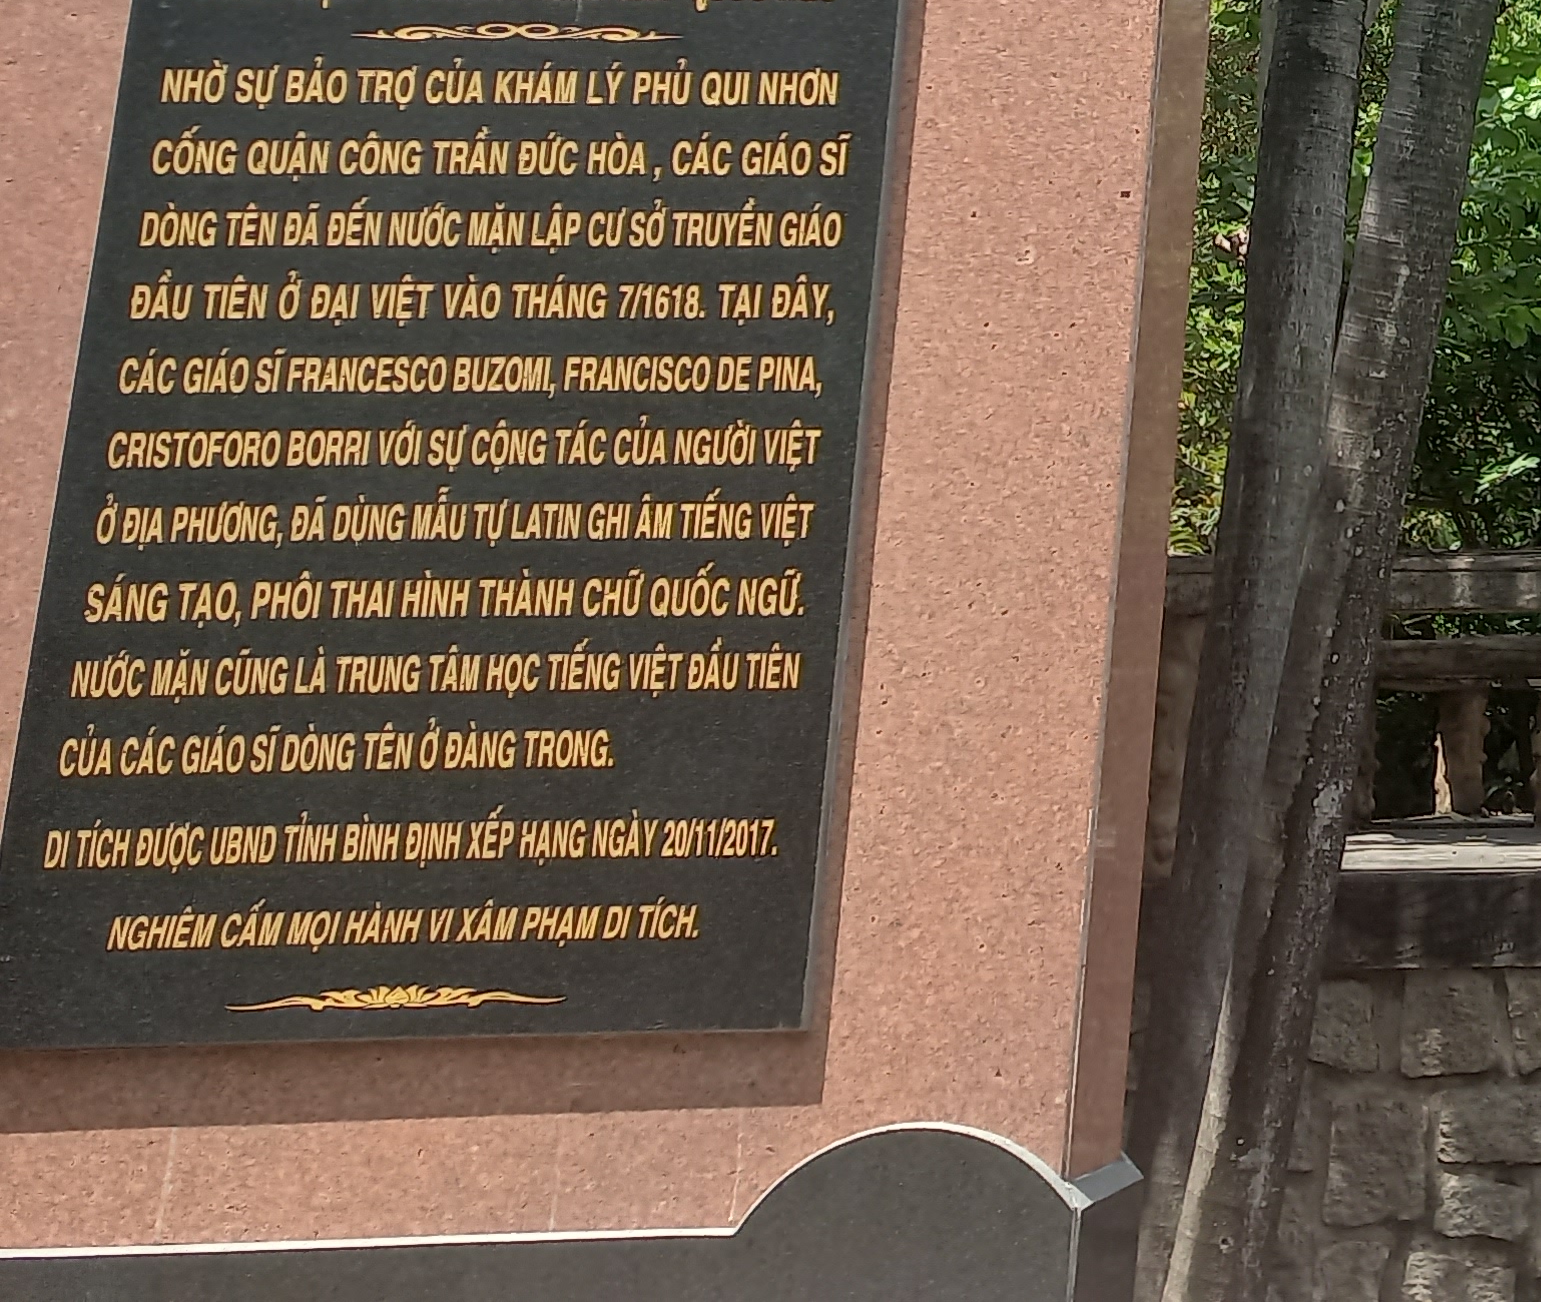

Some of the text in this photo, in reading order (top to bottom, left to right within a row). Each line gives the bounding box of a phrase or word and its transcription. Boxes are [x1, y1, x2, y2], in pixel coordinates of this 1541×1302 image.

[159, 56, 839, 110] NHỜ SỰ BẢO TRỢ CỦA KHÁM LÝ PHỦ QUI NHƠN
[150, 124, 238, 175] CỐNG
[245, 130, 332, 179] QUẬN
[337, 129, 424, 175] CÔNG
[431, 127, 510, 175] TRẦN
[516, 131, 579, 175] ĐỨC
[671, 131, 733, 176] CÁC
[740, 132, 812, 176] GIÁO
[818, 131, 852, 176] SĨ
[138, 196, 842, 253] DÒNG TÊN ĐÃ ĐẾN NƯỚC MẶN LẬP CƯ SỞ TRUYỀN GIÁO
[129, 268, 834, 326] ĐẦU TIÊN Ở ĐẠI VIỆT VÀO THÁNG 7/1618. TẠI ĐÂY,
[117, 347, 822, 395] CÁC GIÁO SĨ FRANCESCO BUZOMI, FRANCISCO DE PINA,
[106, 414, 822, 471] CRISTOFORO BORRI VỚI SỰ CỘNG TÁC CỦA NGƯỜI VIỆT
[95, 485, 817, 548] Ở ĐỊA PHƯƠNG, ĐÃ DÙNG MẪU TỰ LATIN GHI ÂM TIẾNG VIỆT
[83, 560, 804, 624] SÁNG TẠO, PHÔI THAI HÌNH THÀNH CHỮ QUỐC NGỮ.
[42, 805, 778, 873] DI TÍCH ĐƯỢC UBND TỈNH BÌNH ĐỊNH XẾP HẠNG NGÀY 20/11/2017.
[106, 896, 699, 952] NGHIÊM CẤM MỌI HÀNH VI XÂM PHẠM DI TÍCH.
